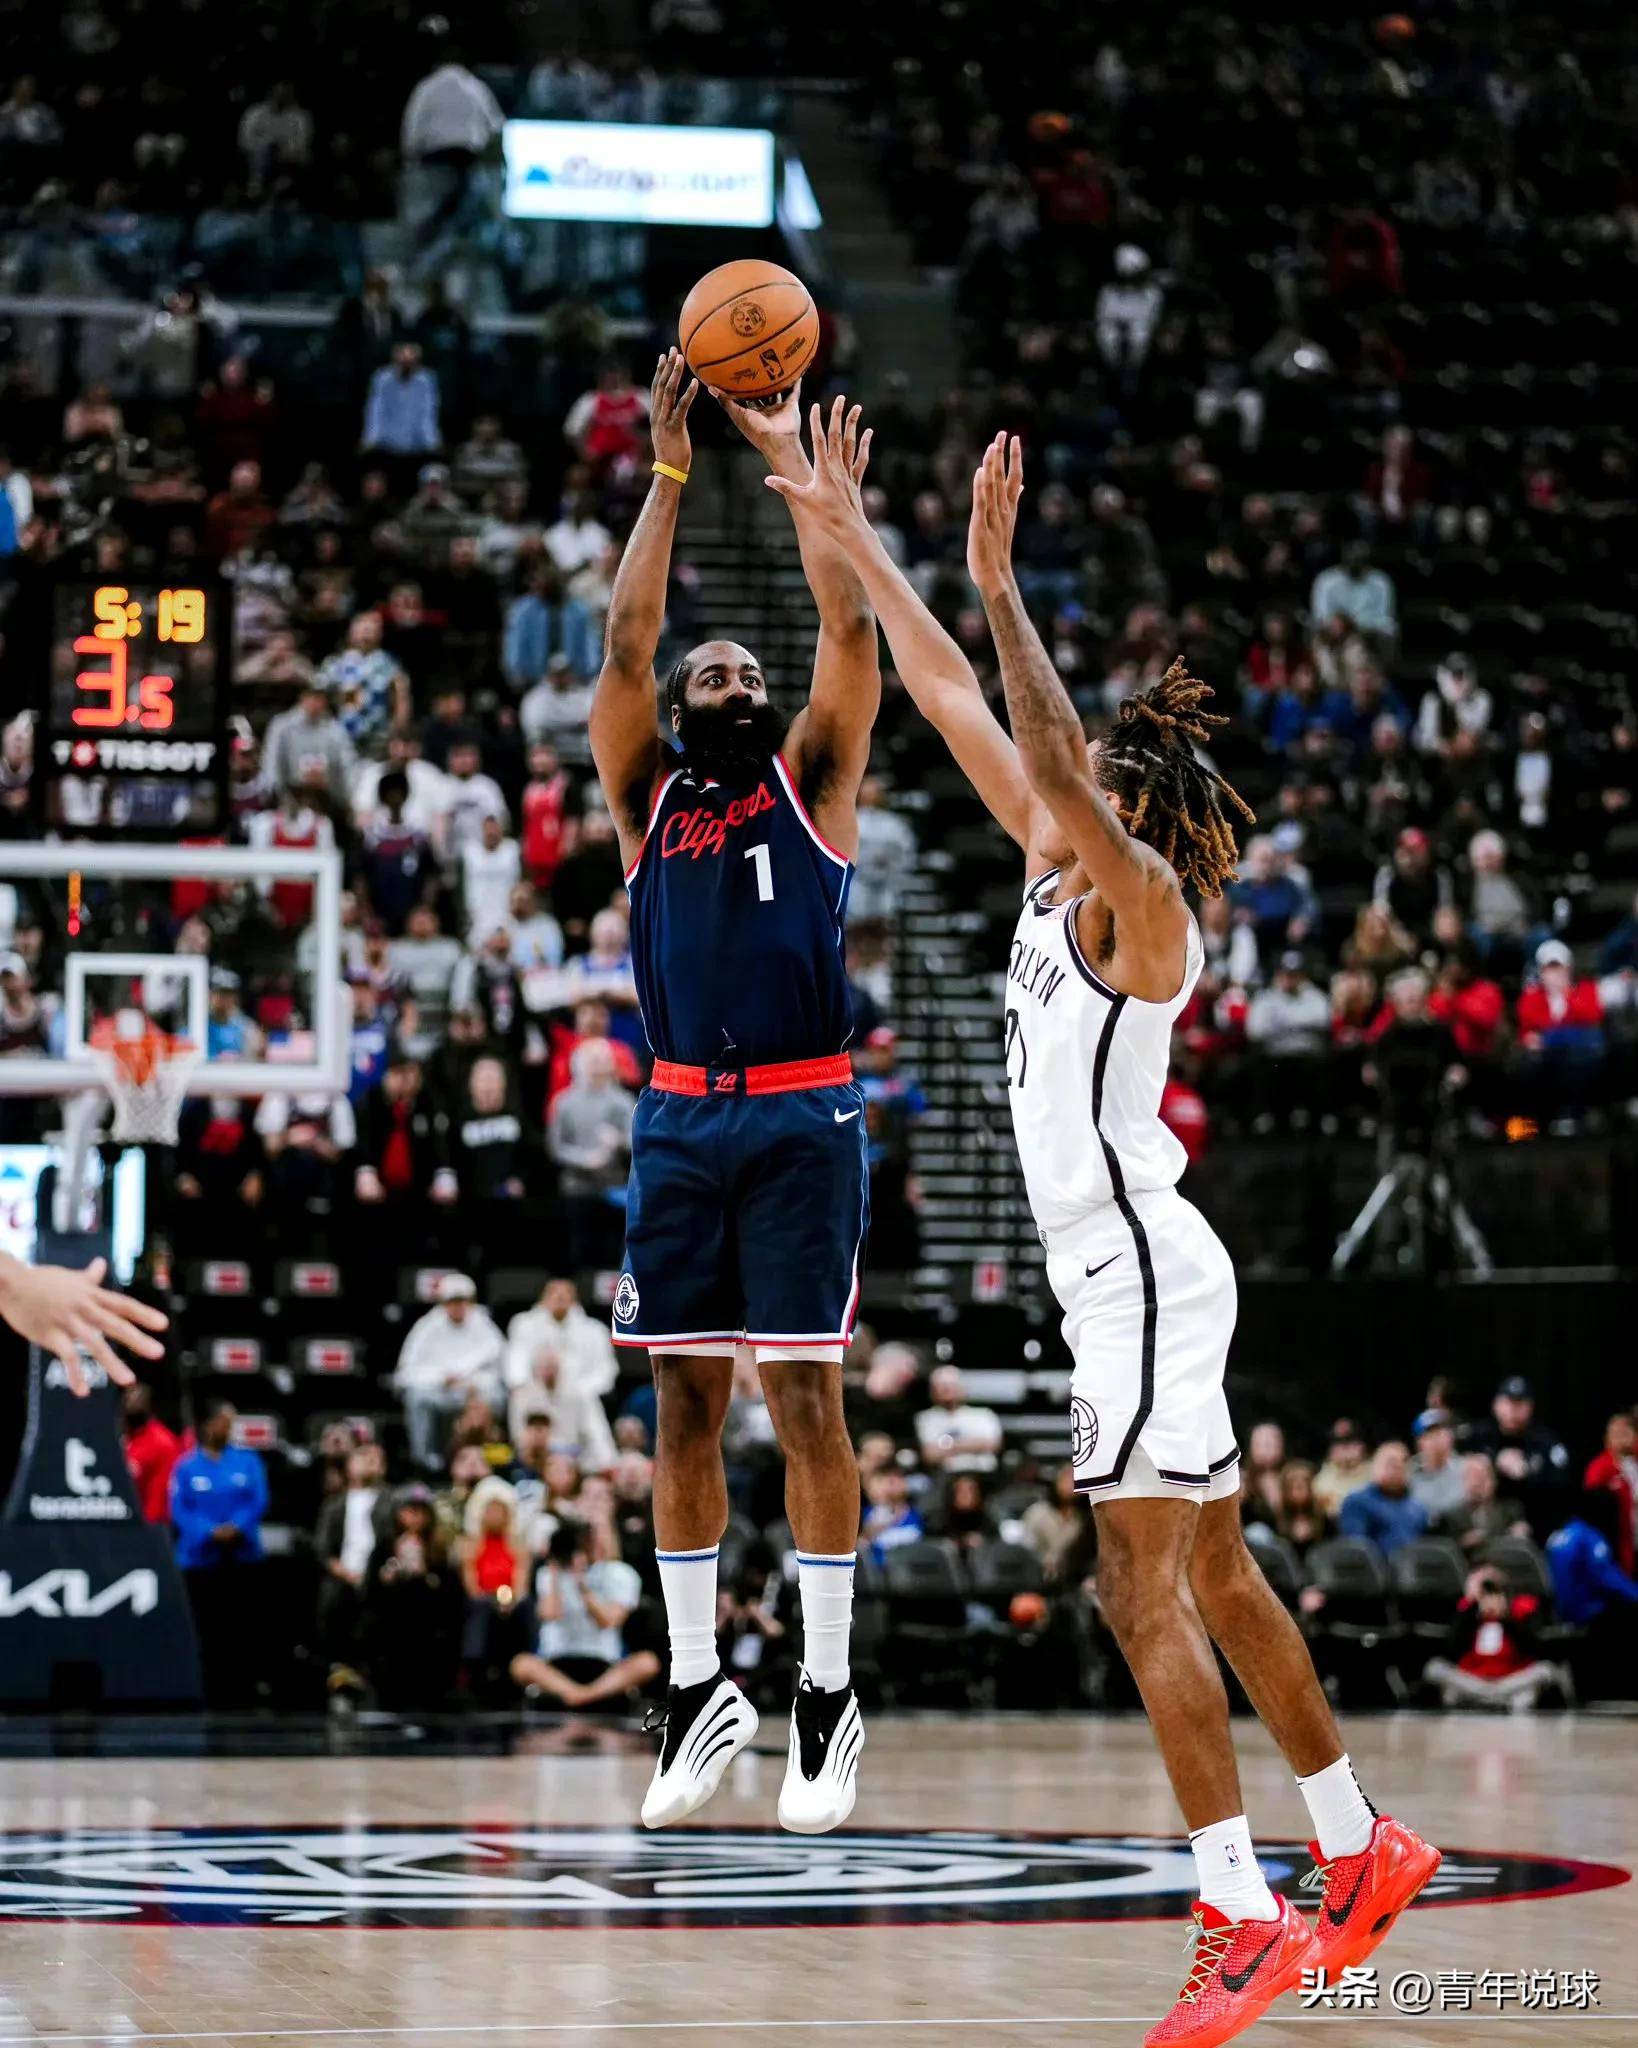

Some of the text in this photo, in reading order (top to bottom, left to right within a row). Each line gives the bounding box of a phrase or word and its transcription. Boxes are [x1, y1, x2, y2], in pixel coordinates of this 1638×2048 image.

[94, 586, 206, 643] 5:19
[72, 636, 174, 729] 3.5
[98, 740, 216, 772] TISSOT
[743, 843, 775, 902] 1
[0, 1568, 158, 1617] KIA
